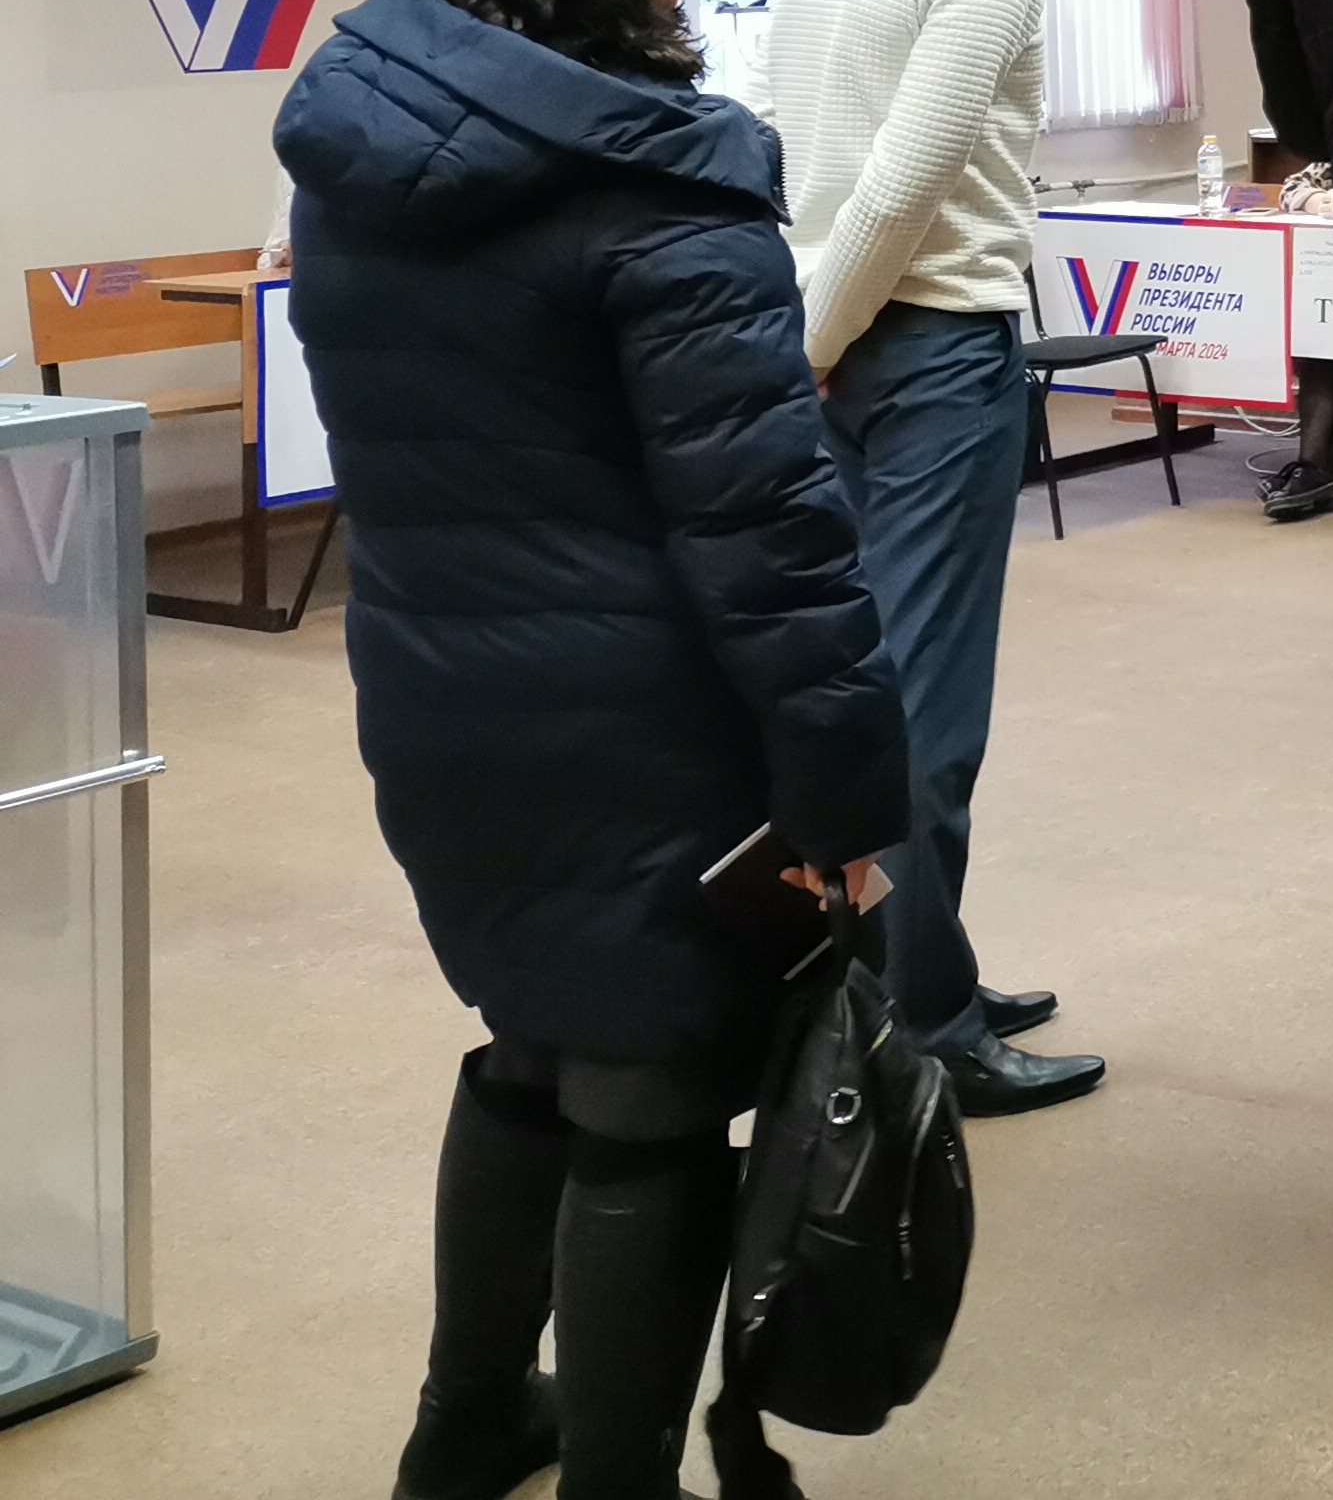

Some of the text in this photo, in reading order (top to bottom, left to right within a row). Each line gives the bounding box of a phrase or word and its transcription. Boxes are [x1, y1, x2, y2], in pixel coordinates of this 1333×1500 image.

[1147, 262, 1222, 284] ВЫБОРЫ
[1139, 288, 1243, 312] ПРЕЗИДЕНТА
[1130, 313, 1197, 335] РОССИИ
[1198, 342, 1229, 360] 2024
